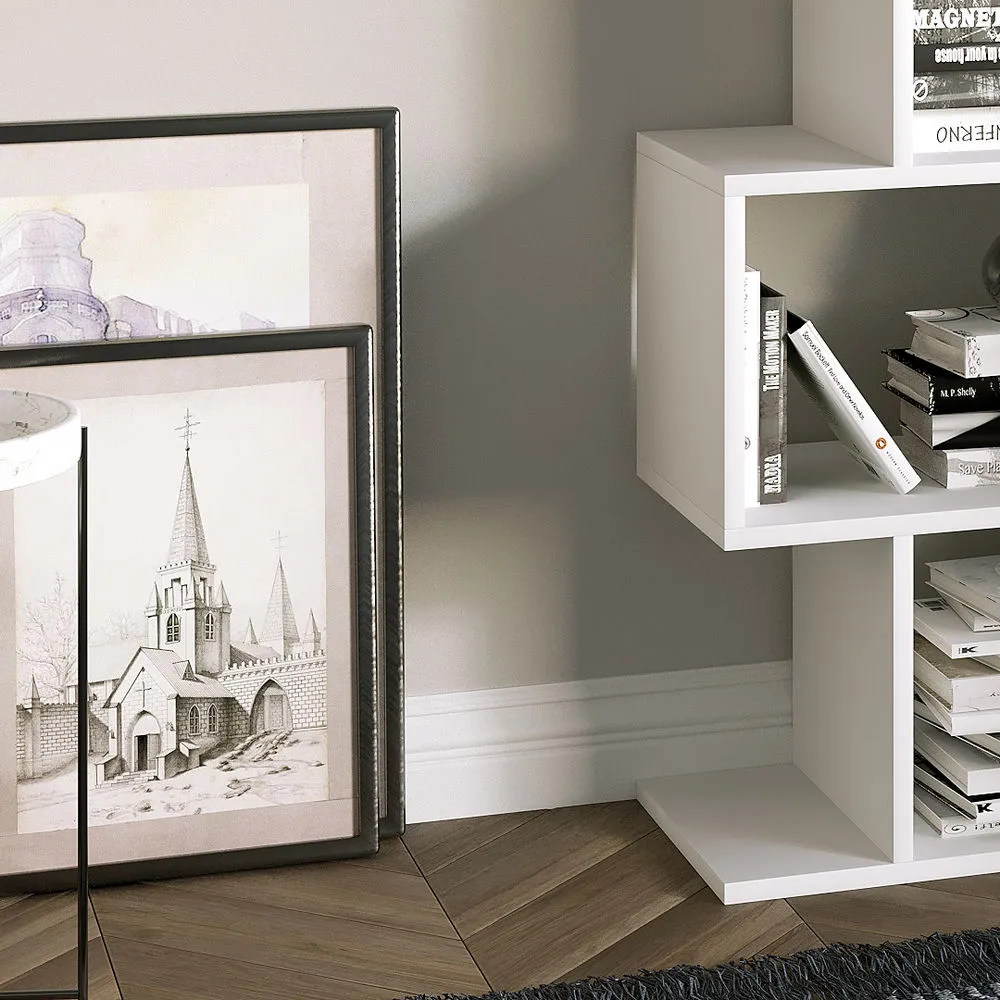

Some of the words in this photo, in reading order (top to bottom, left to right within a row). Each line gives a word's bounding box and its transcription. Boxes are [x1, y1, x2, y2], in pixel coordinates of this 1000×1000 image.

[934, 47, 963, 64] house
[963, 45, 986, 62] your
[986, 46, 996, 62] in
[762, 309, 779, 339] MAKER
[762, 341, 779, 373] MOTION
[762, 374, 779, 391] THE
[958, 461, 984, 476] Save
